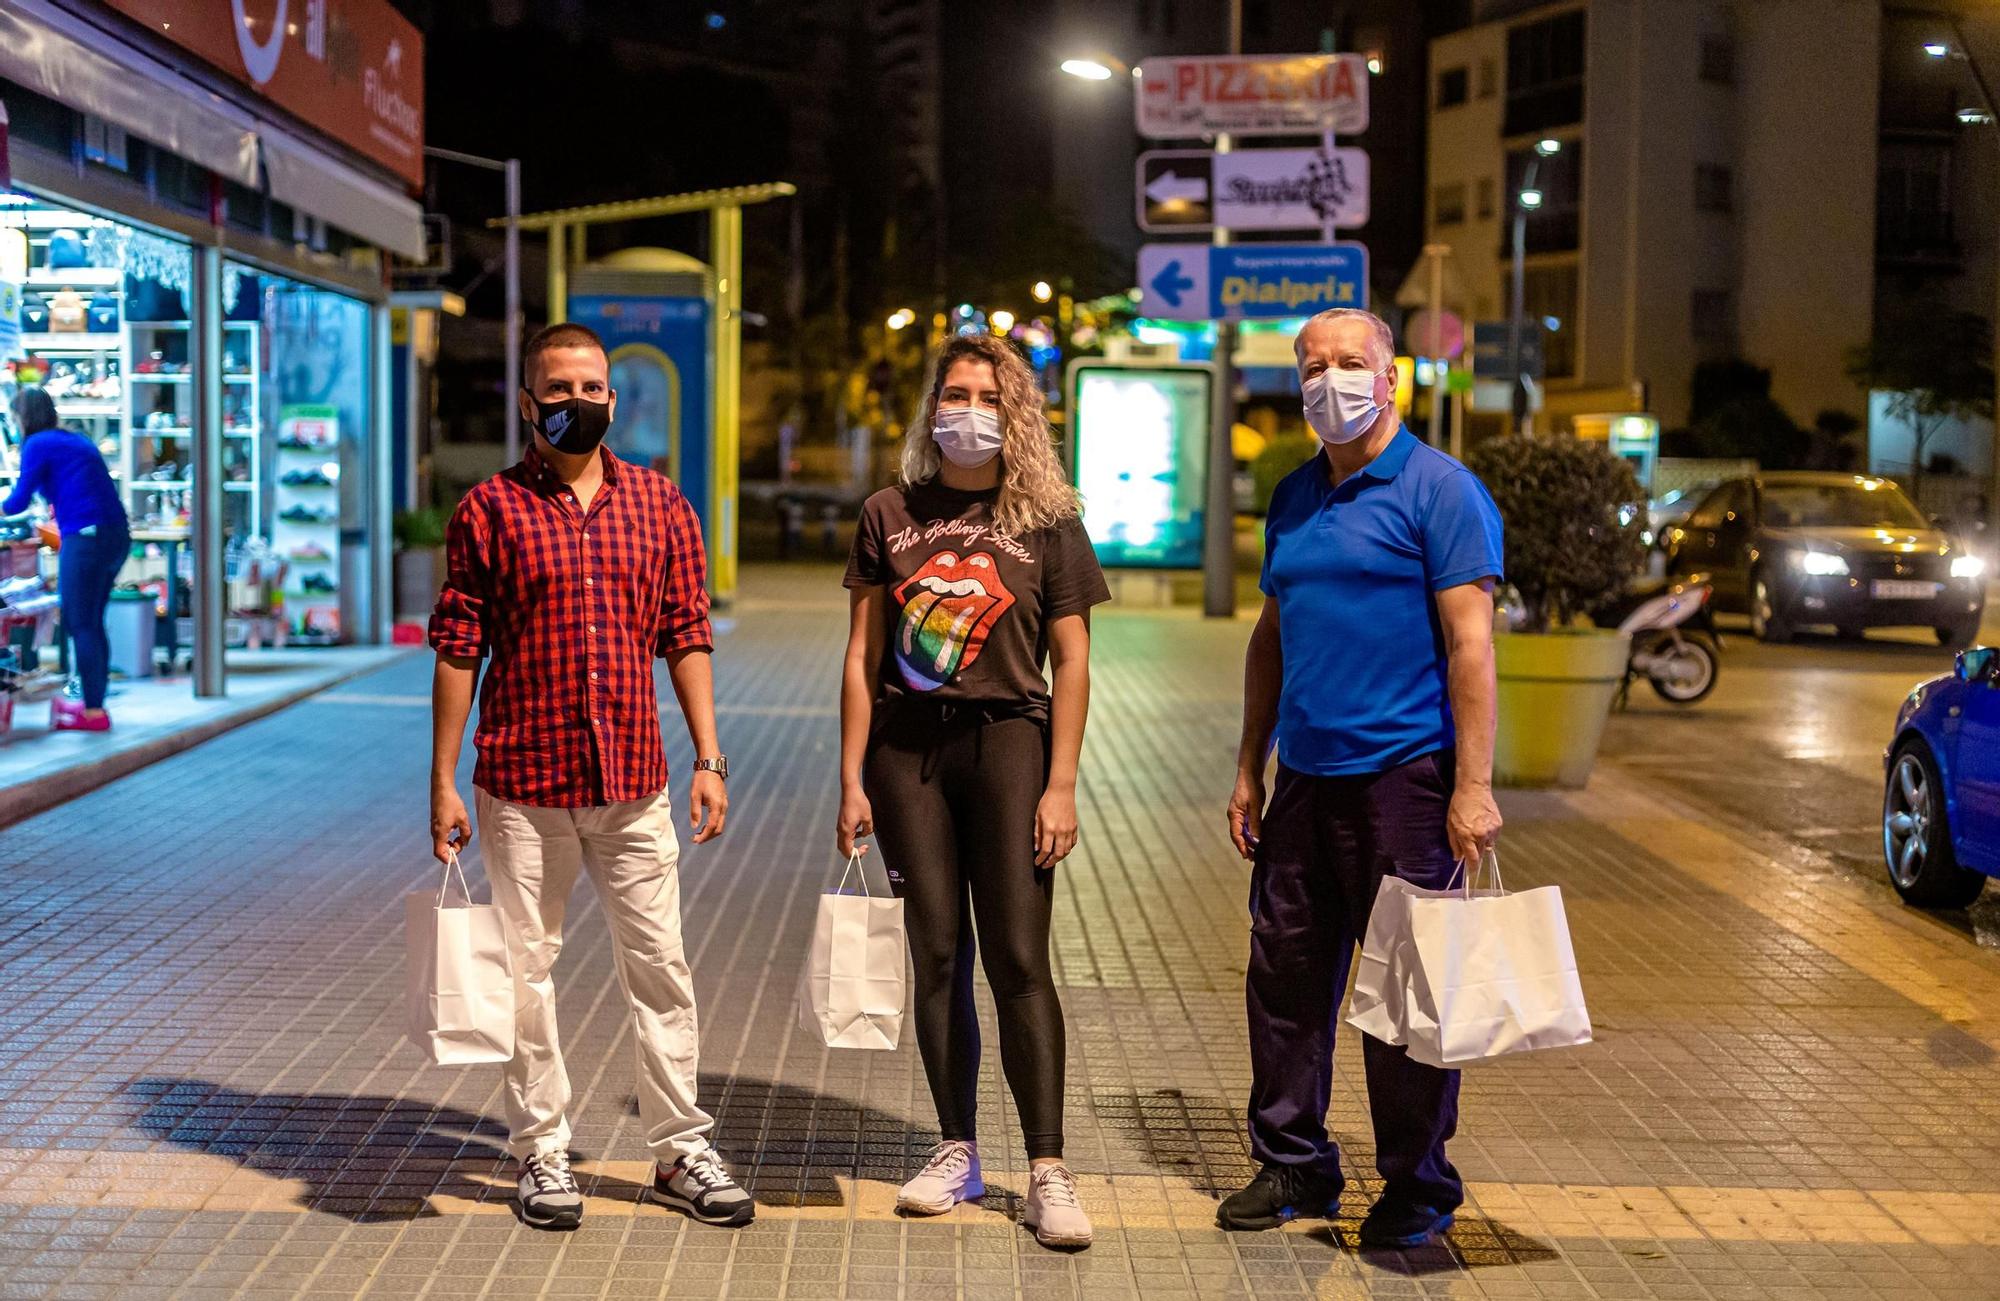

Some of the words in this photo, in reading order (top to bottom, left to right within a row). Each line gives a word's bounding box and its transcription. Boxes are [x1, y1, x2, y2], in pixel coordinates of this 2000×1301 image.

[1221, 275, 1355, 309] Dialprix
[545, 409, 568, 433] NIKE
[887, 526, 921, 554] The
[925, 518, 989, 547] Rolling
[983, 529, 1035, 563] Stones
